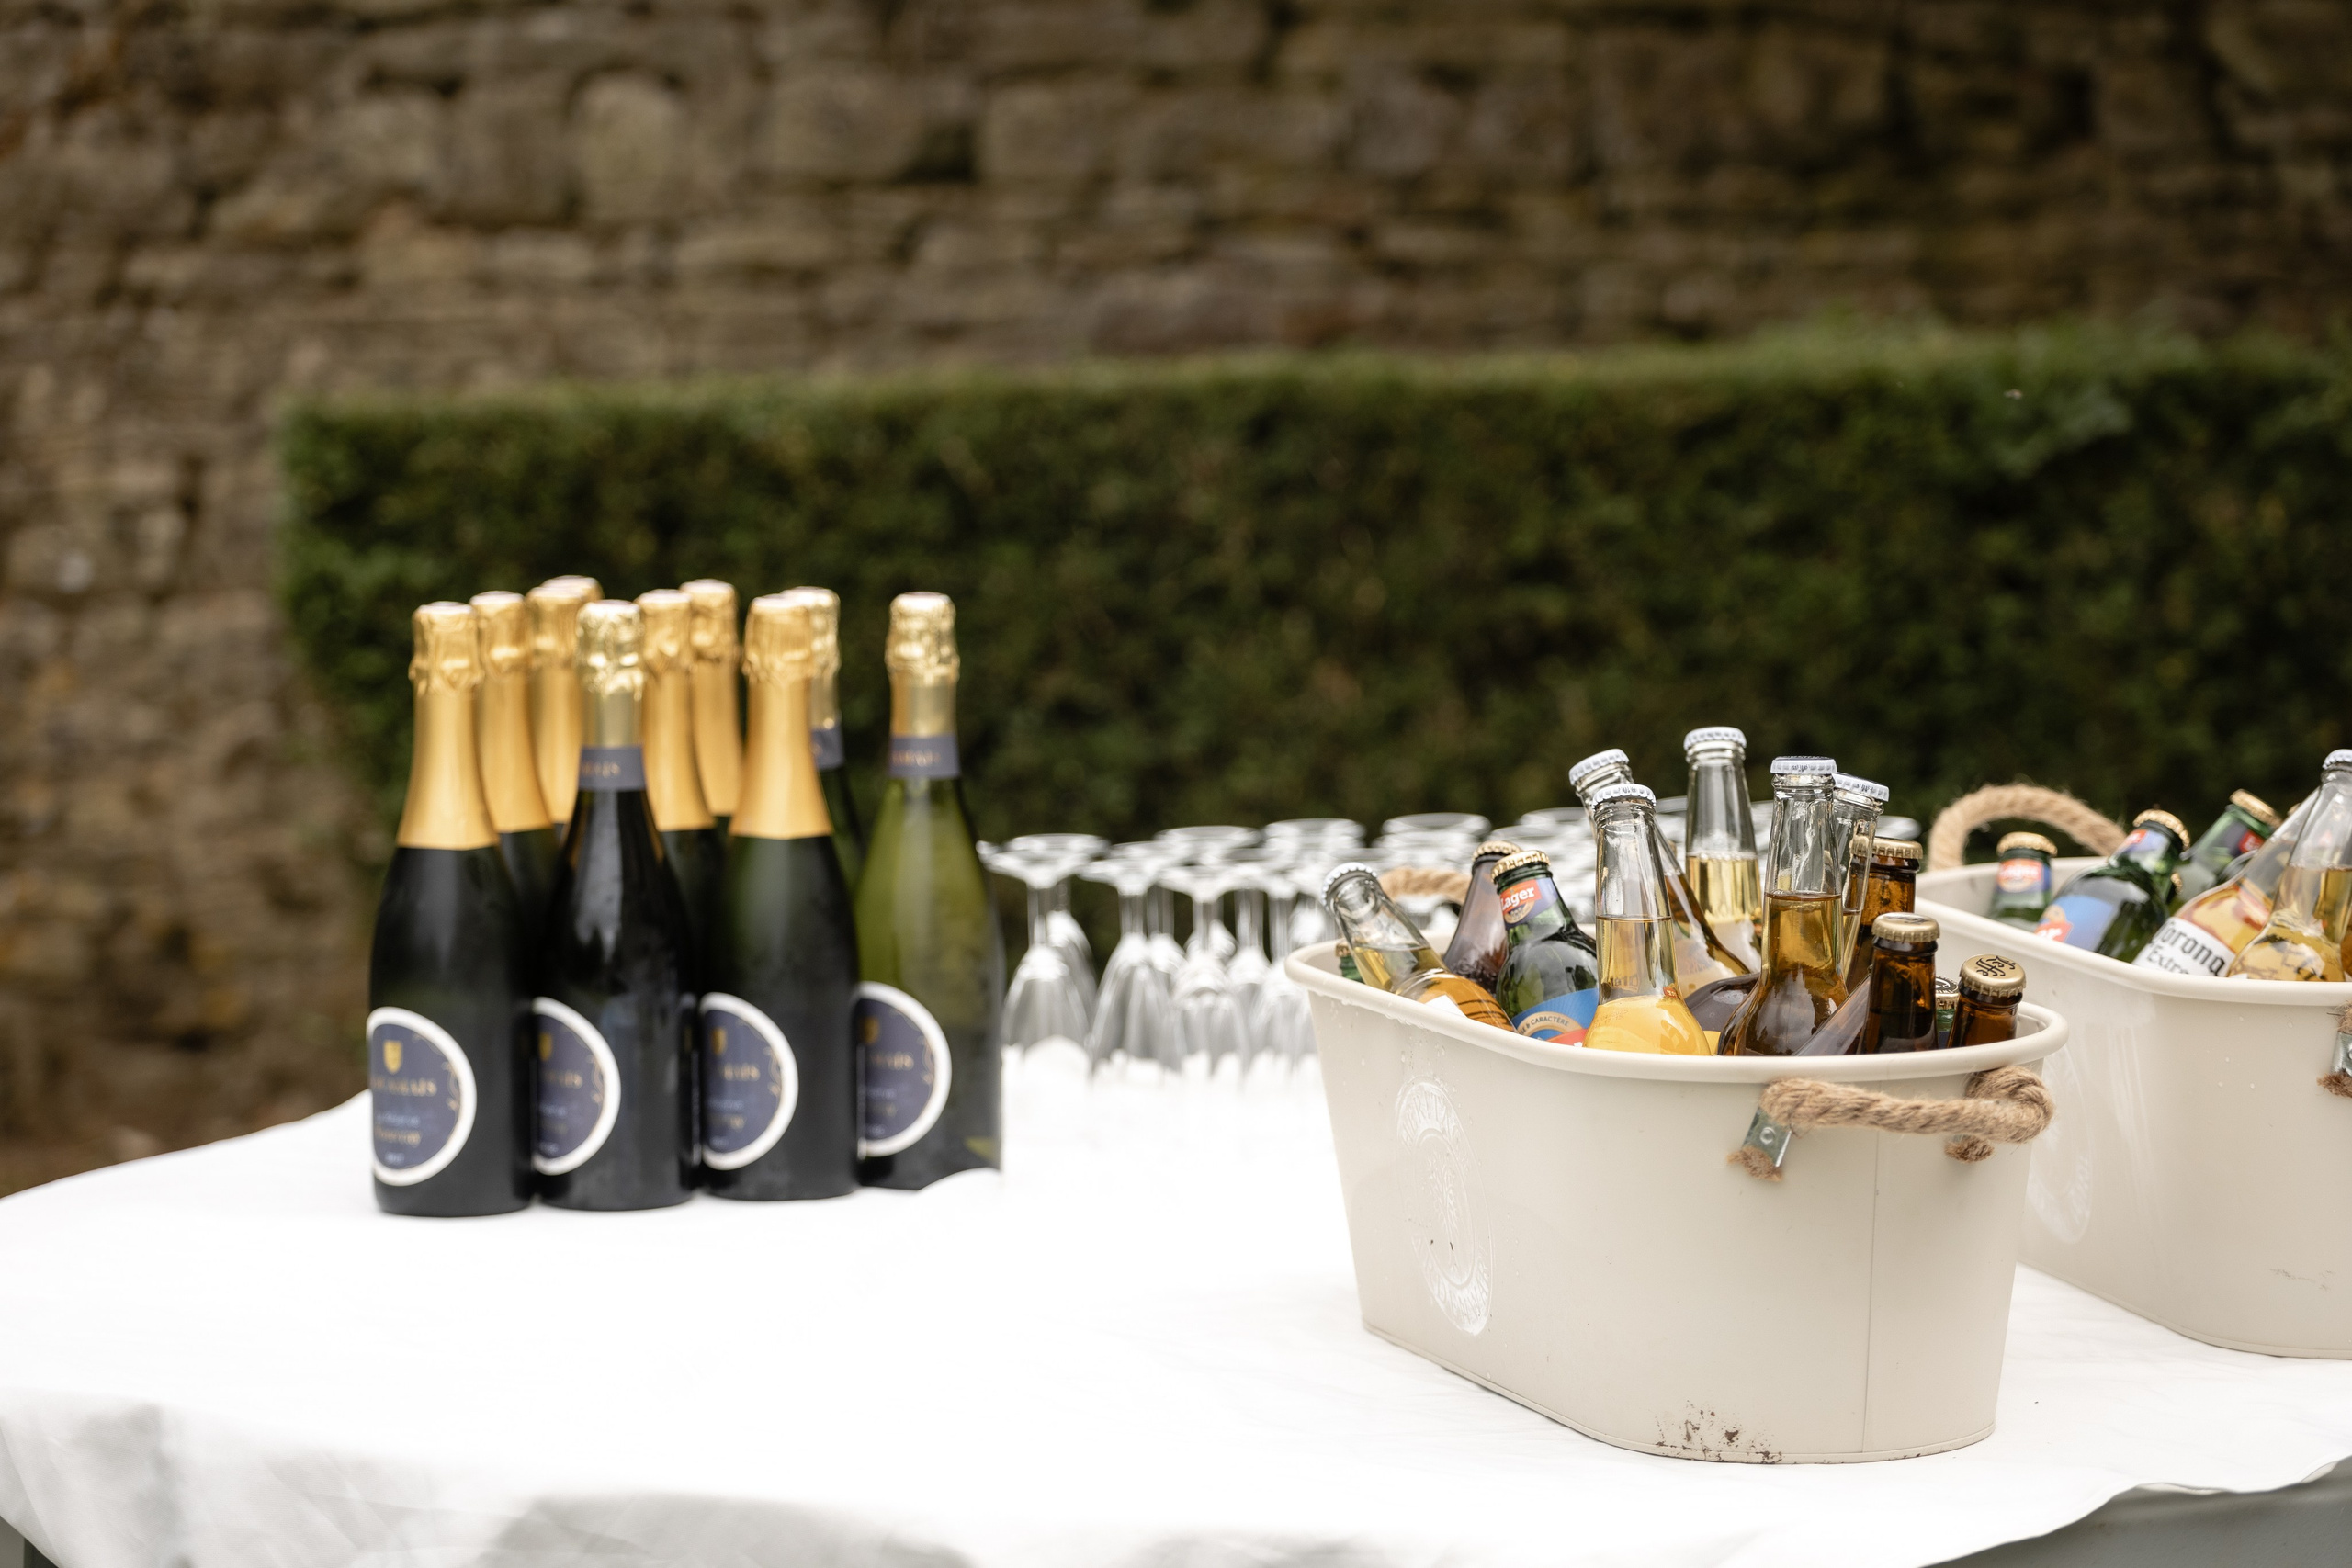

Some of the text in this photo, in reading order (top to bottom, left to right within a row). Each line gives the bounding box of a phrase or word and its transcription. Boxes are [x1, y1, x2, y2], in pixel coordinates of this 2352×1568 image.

[1500, 886, 1535, 910] Lager
[2151, 919, 2225, 976] Corona
[1975, 955, 2016, 976] Leffe
[1531, 1015, 1569, 1027] CARACTÈRE
